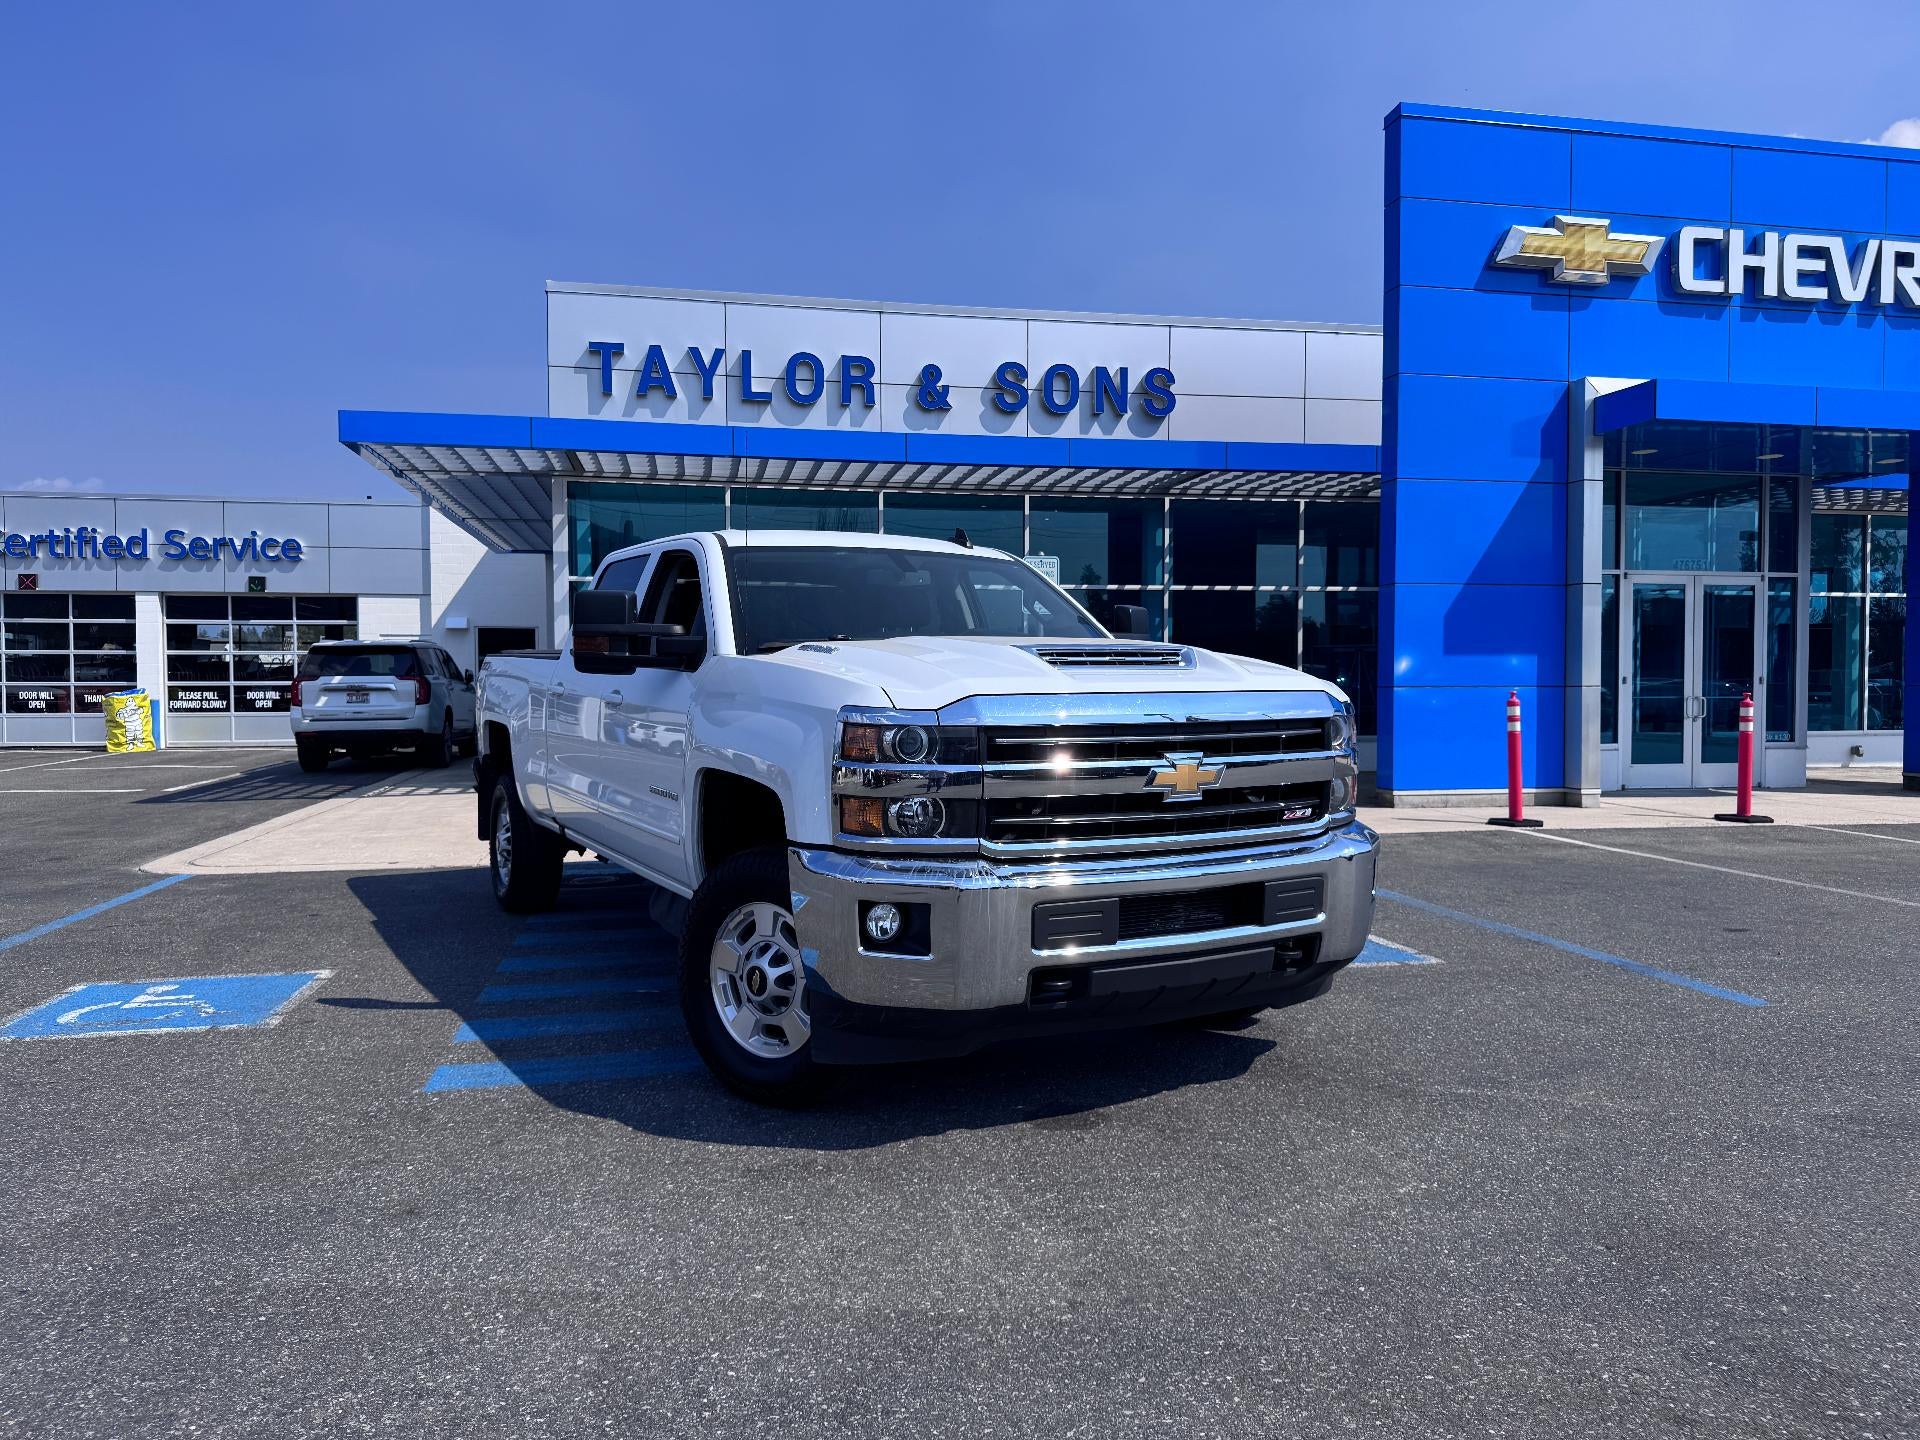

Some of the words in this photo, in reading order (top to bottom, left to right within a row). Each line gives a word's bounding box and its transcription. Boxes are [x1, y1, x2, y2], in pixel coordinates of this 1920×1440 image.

[1672, 225, 1920, 307] CHEVR
[588, 341, 877, 407] TAYLOR
[917, 362, 953, 411] &
[995, 360, 1177, 418] SONS
[0, 526, 149, 559] ertified
[164, 529, 303, 561] Service
[19, 691, 37, 700] DOOR
[38, 691, 54, 700] WILL
[83, 694, 104, 703] THAN
[178, 691, 202, 700] PLEASE
[203, 691, 218, 700] PULL
[246, 691, 264, 700] DOOR
[265, 691, 280, 700] WILL
[28, 700, 46, 709] OPEN
[169, 700, 201, 709] FORWARD
[201, 700, 227, 709] SLOWLY
[255, 700, 273, 708] OPEN
